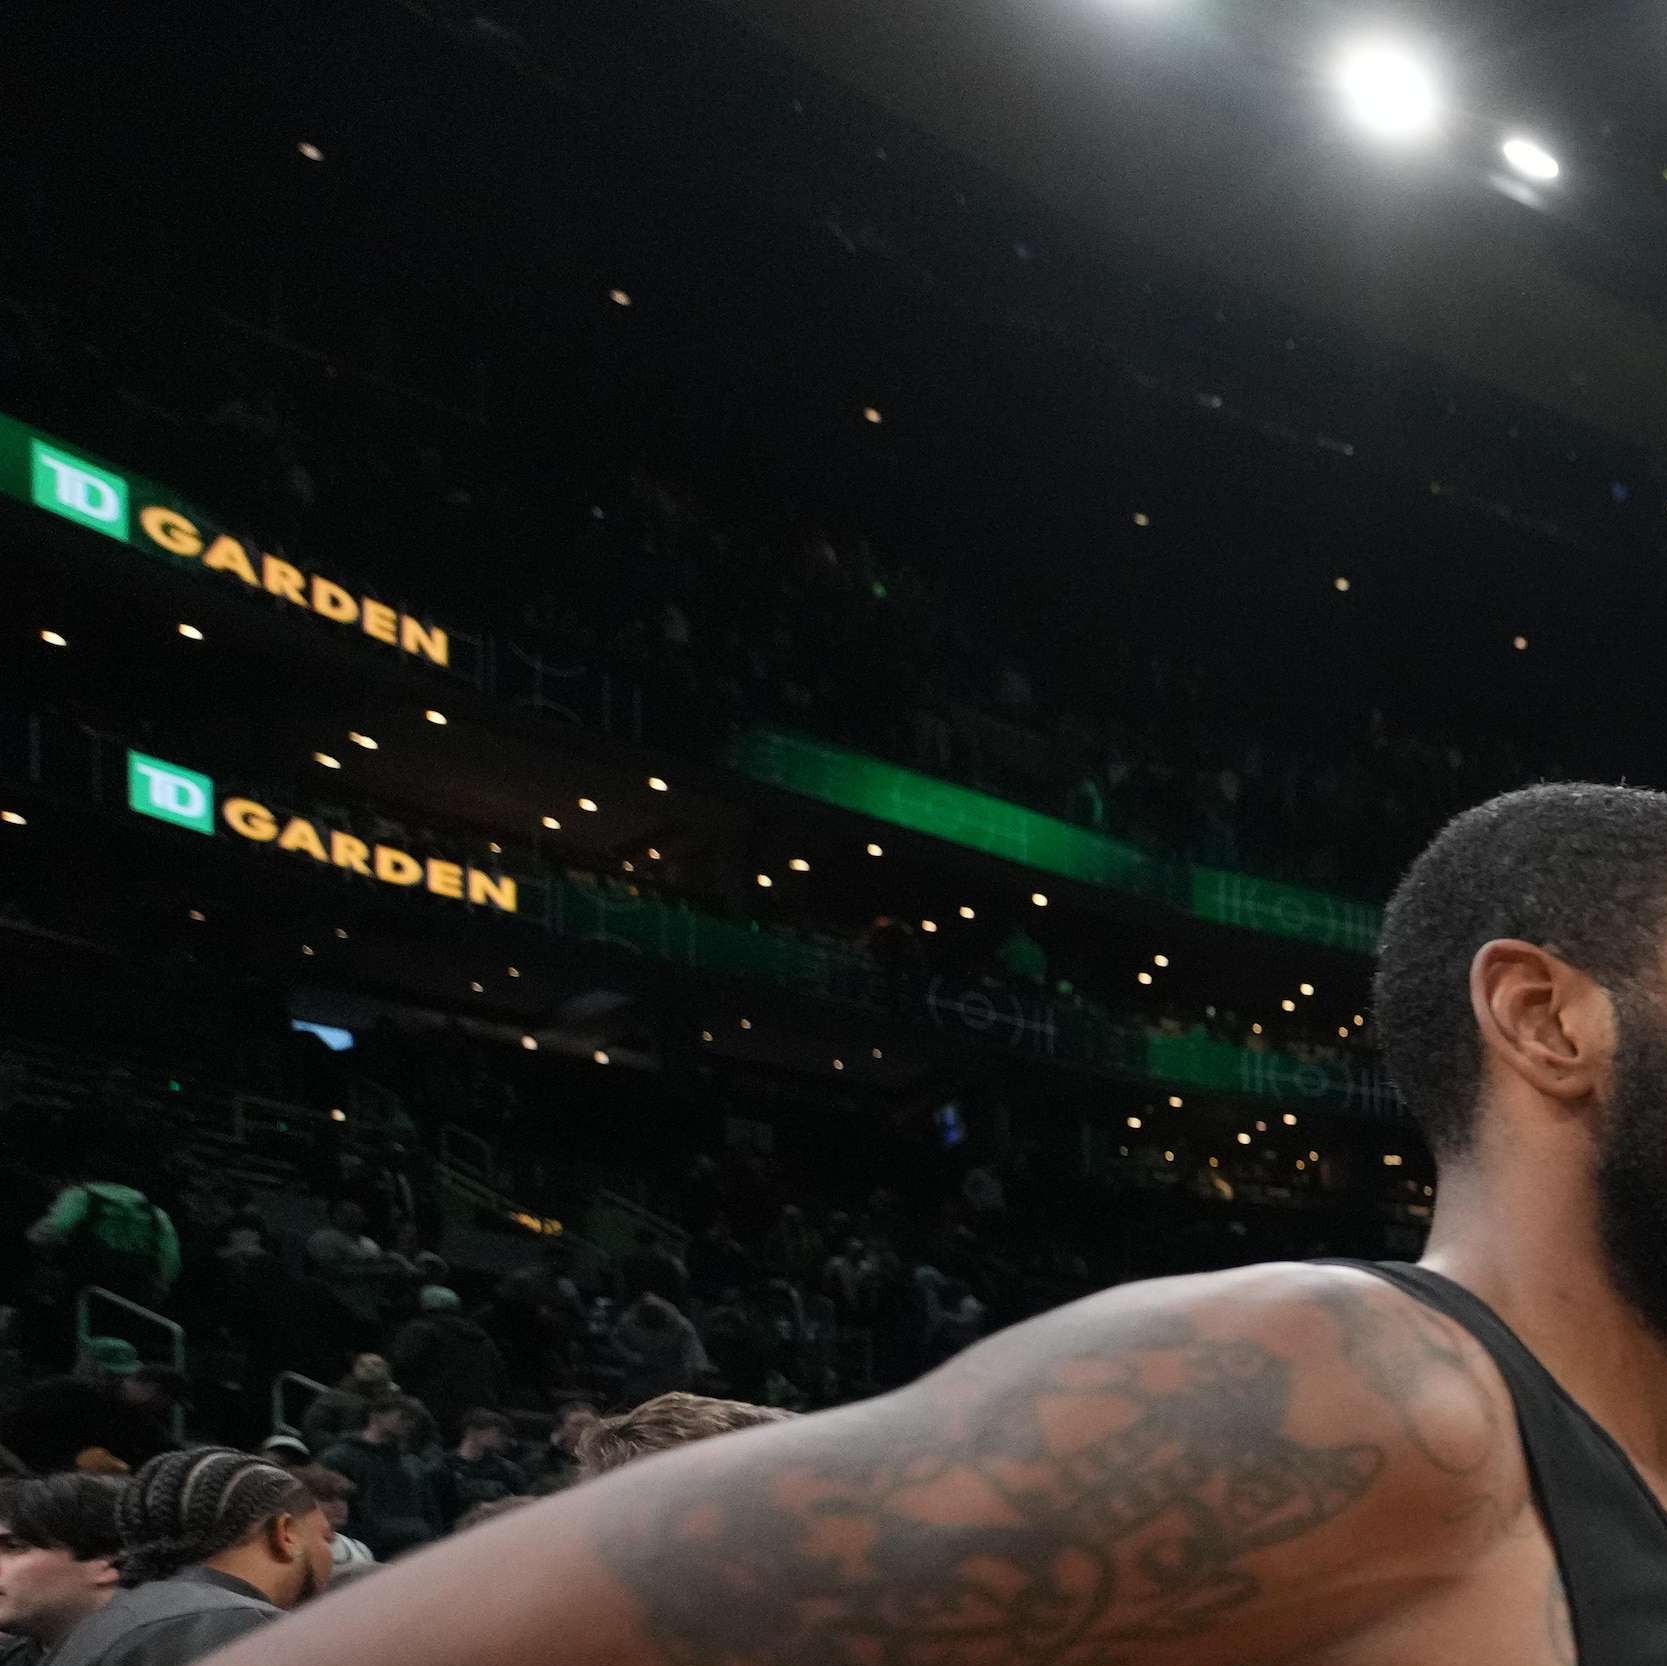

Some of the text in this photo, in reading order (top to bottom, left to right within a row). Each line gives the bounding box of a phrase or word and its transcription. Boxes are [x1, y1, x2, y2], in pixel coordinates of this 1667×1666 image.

[41, 454, 449, 667] TD GARDEN
[137, 762, 518, 913] TD GARDEN
